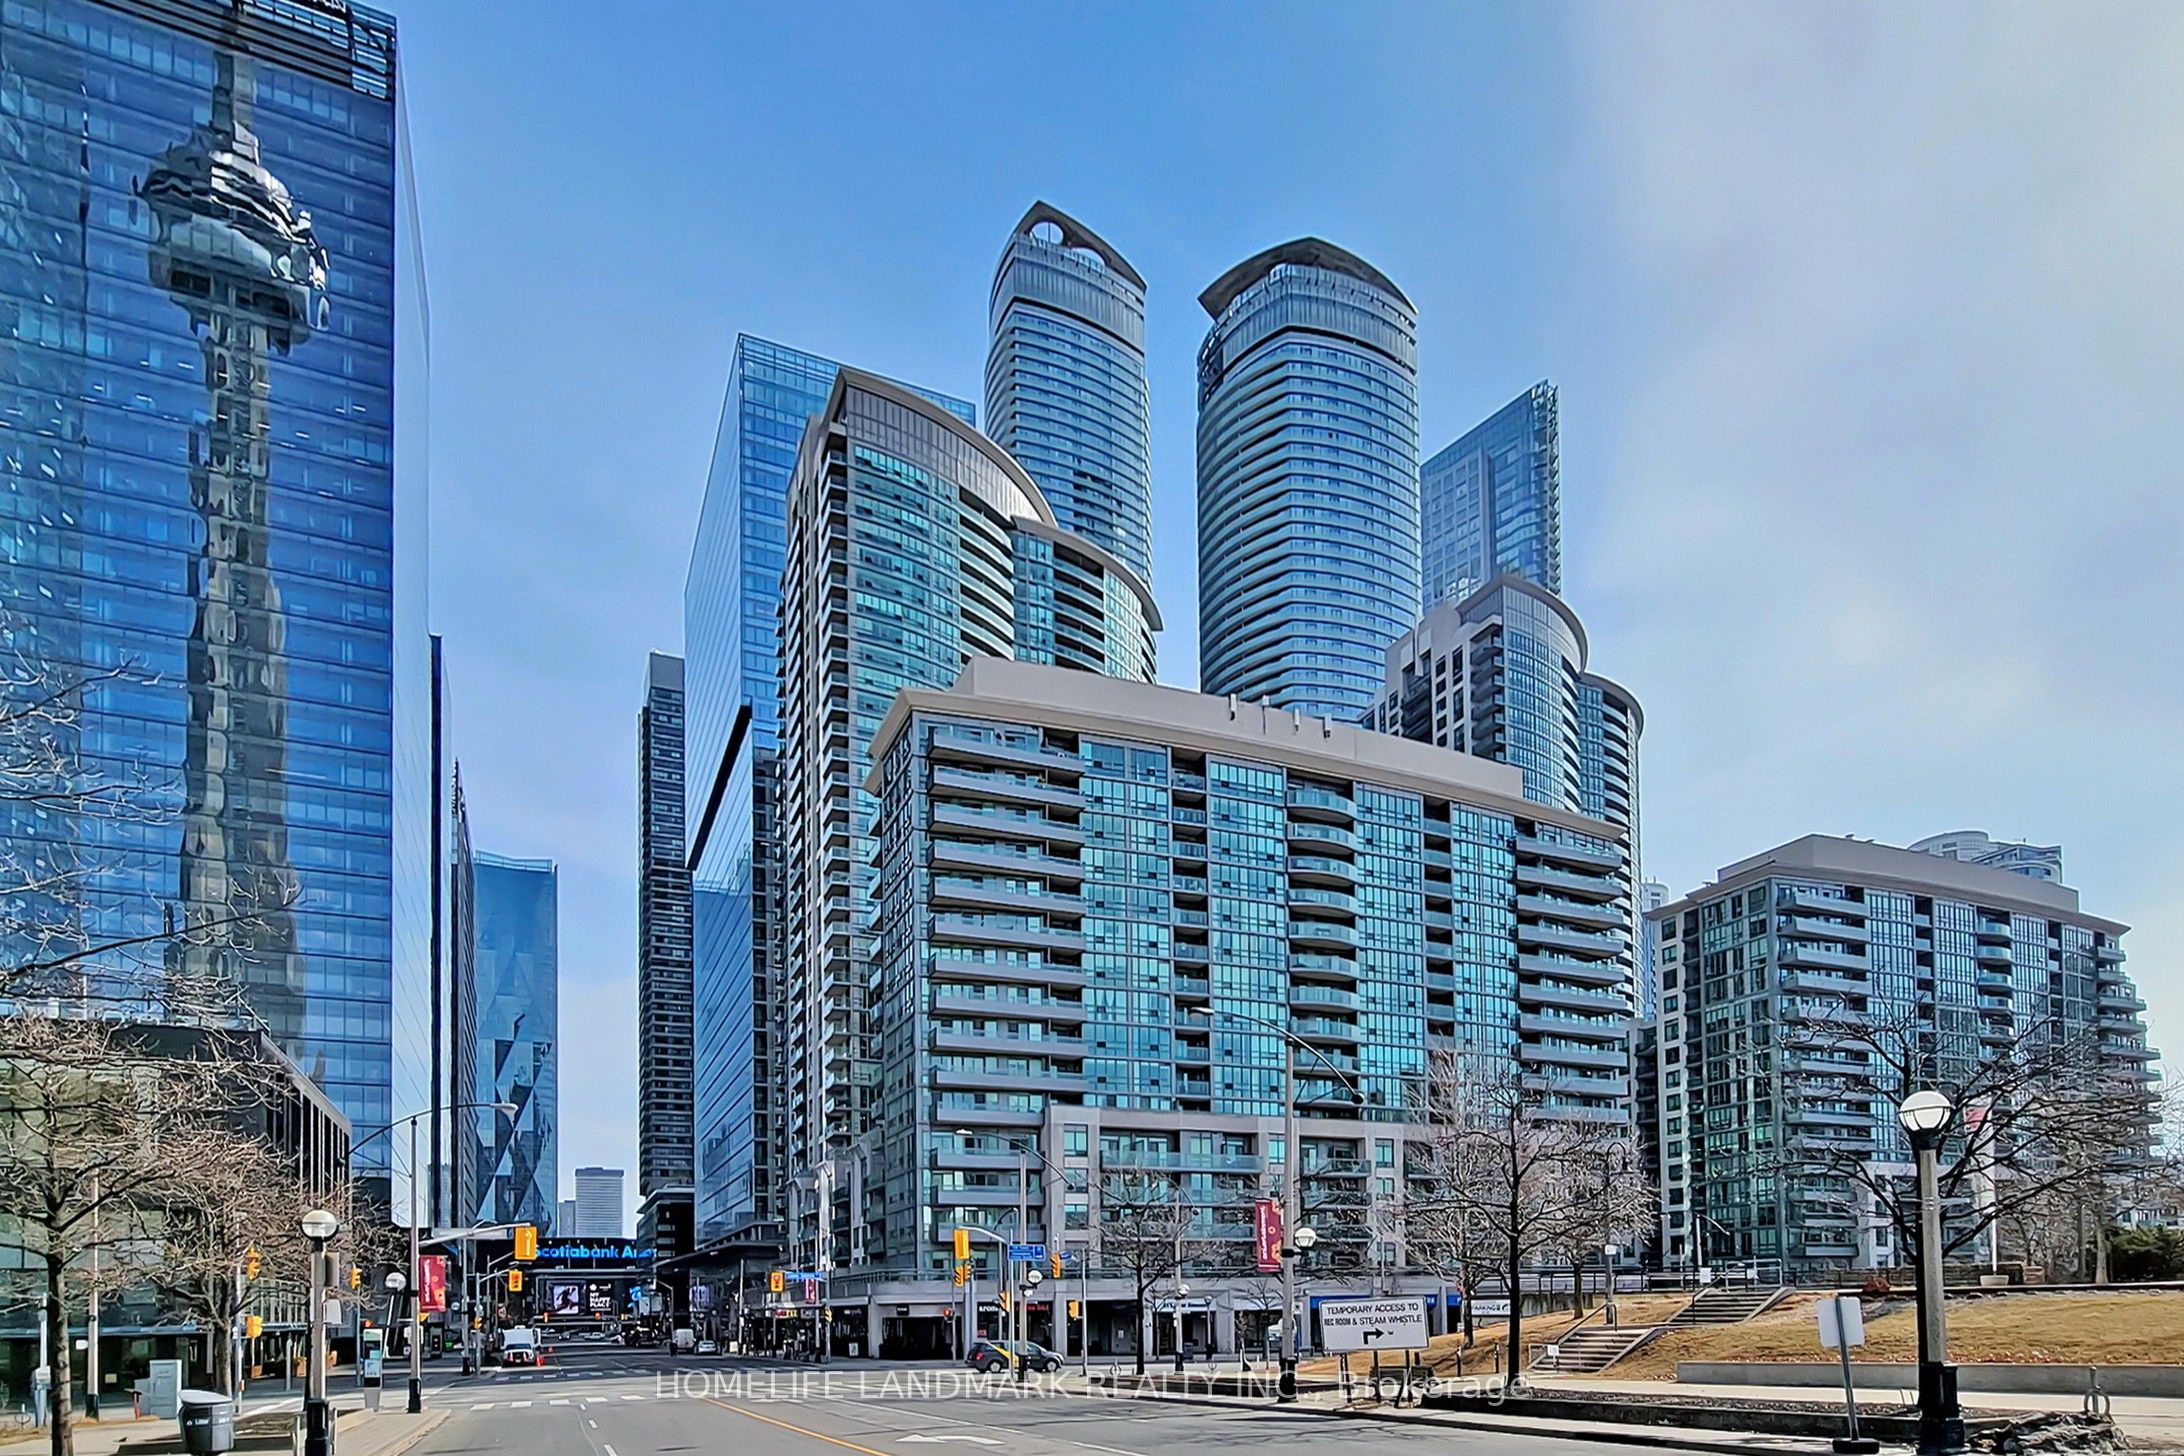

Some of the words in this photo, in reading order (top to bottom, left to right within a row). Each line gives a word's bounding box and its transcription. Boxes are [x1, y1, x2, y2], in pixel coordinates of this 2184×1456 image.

[1326, 1305, 1373, 1315] TEMPORARY
[1374, 1303, 1406, 1313] ACCESS
[1408, 1302, 1419, 1311] TO
[1324, 1318, 1335, 1326] REC
[1335, 1317, 1351, 1326] ROOM
[1352, 1317, 1358, 1326] &
[1359, 1316, 1386, 1326] STEAM
[1387, 1314, 1422, 1324] WHISTLE
